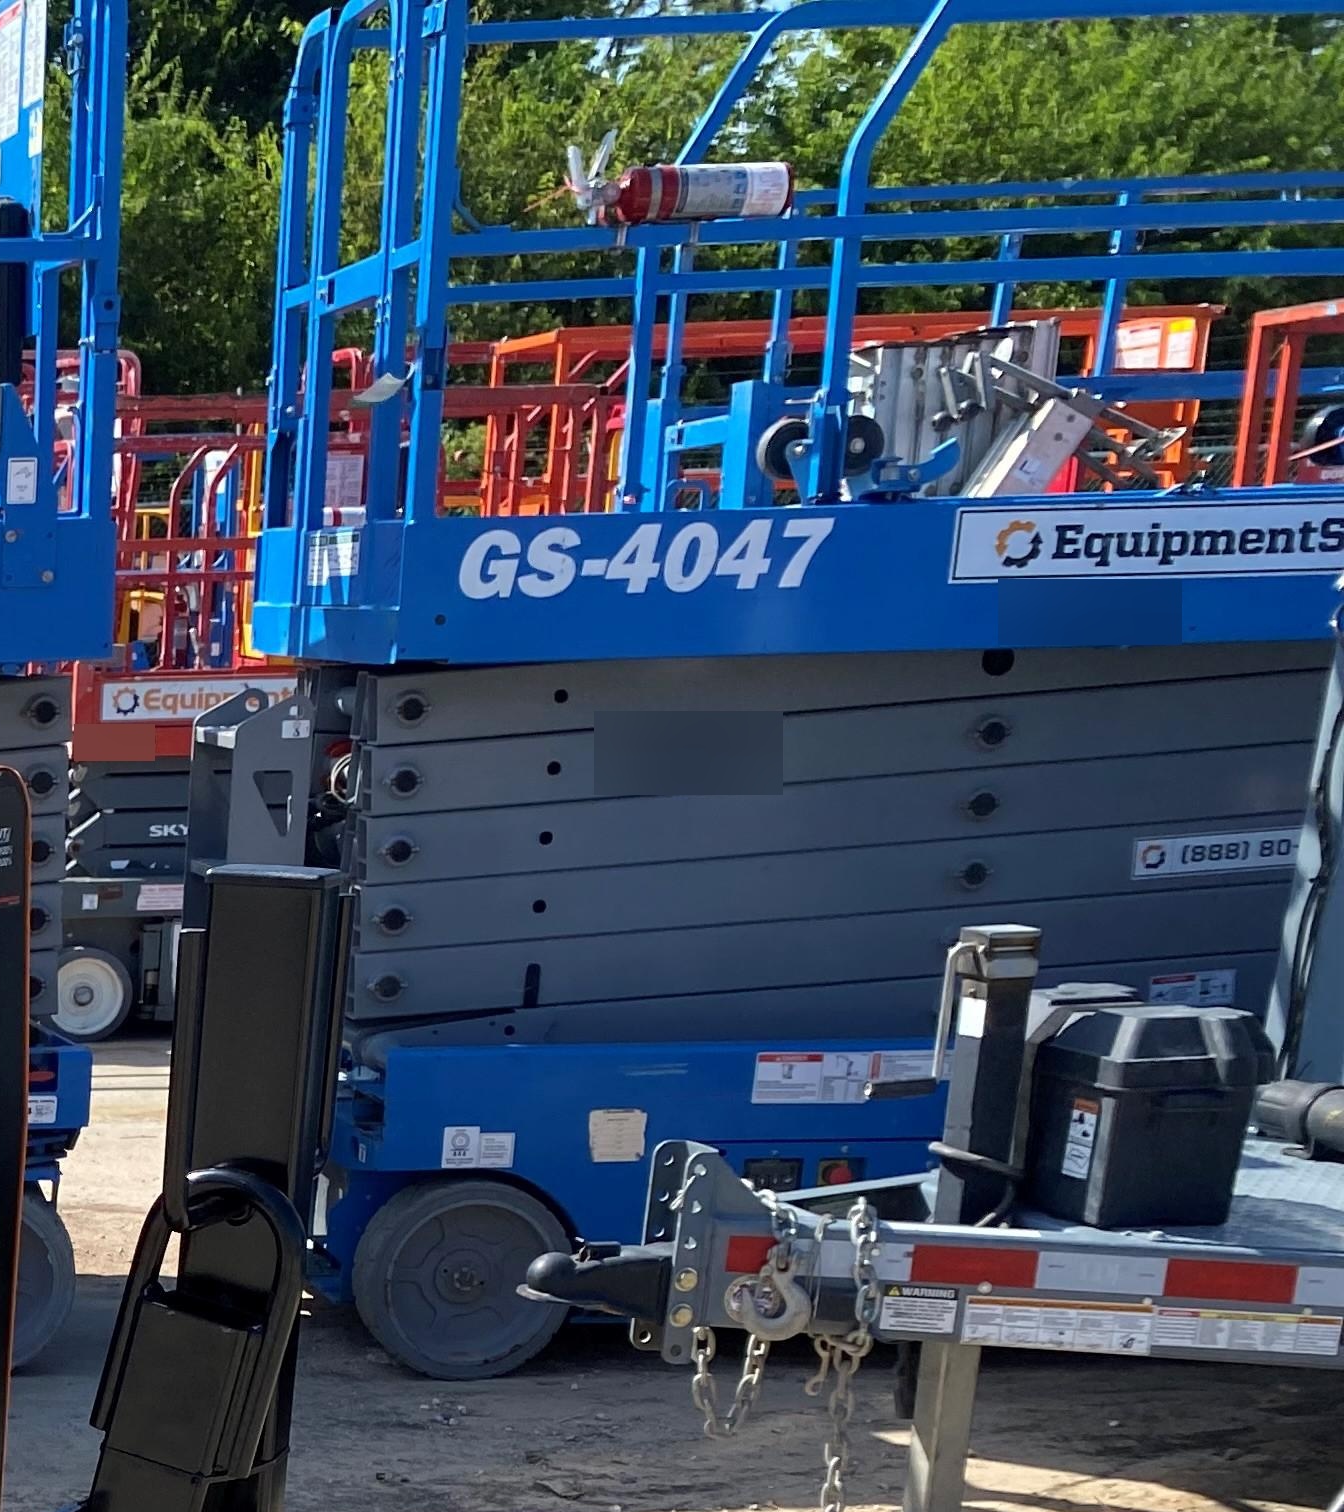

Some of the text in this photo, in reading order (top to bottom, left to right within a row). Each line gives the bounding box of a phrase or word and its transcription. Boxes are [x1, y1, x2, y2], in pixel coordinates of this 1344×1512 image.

[459, 517, 836, 600] GS-4047
[1181, 840, 1250, 864] (888)
[902, 1287, 955, 1300] WARNING
